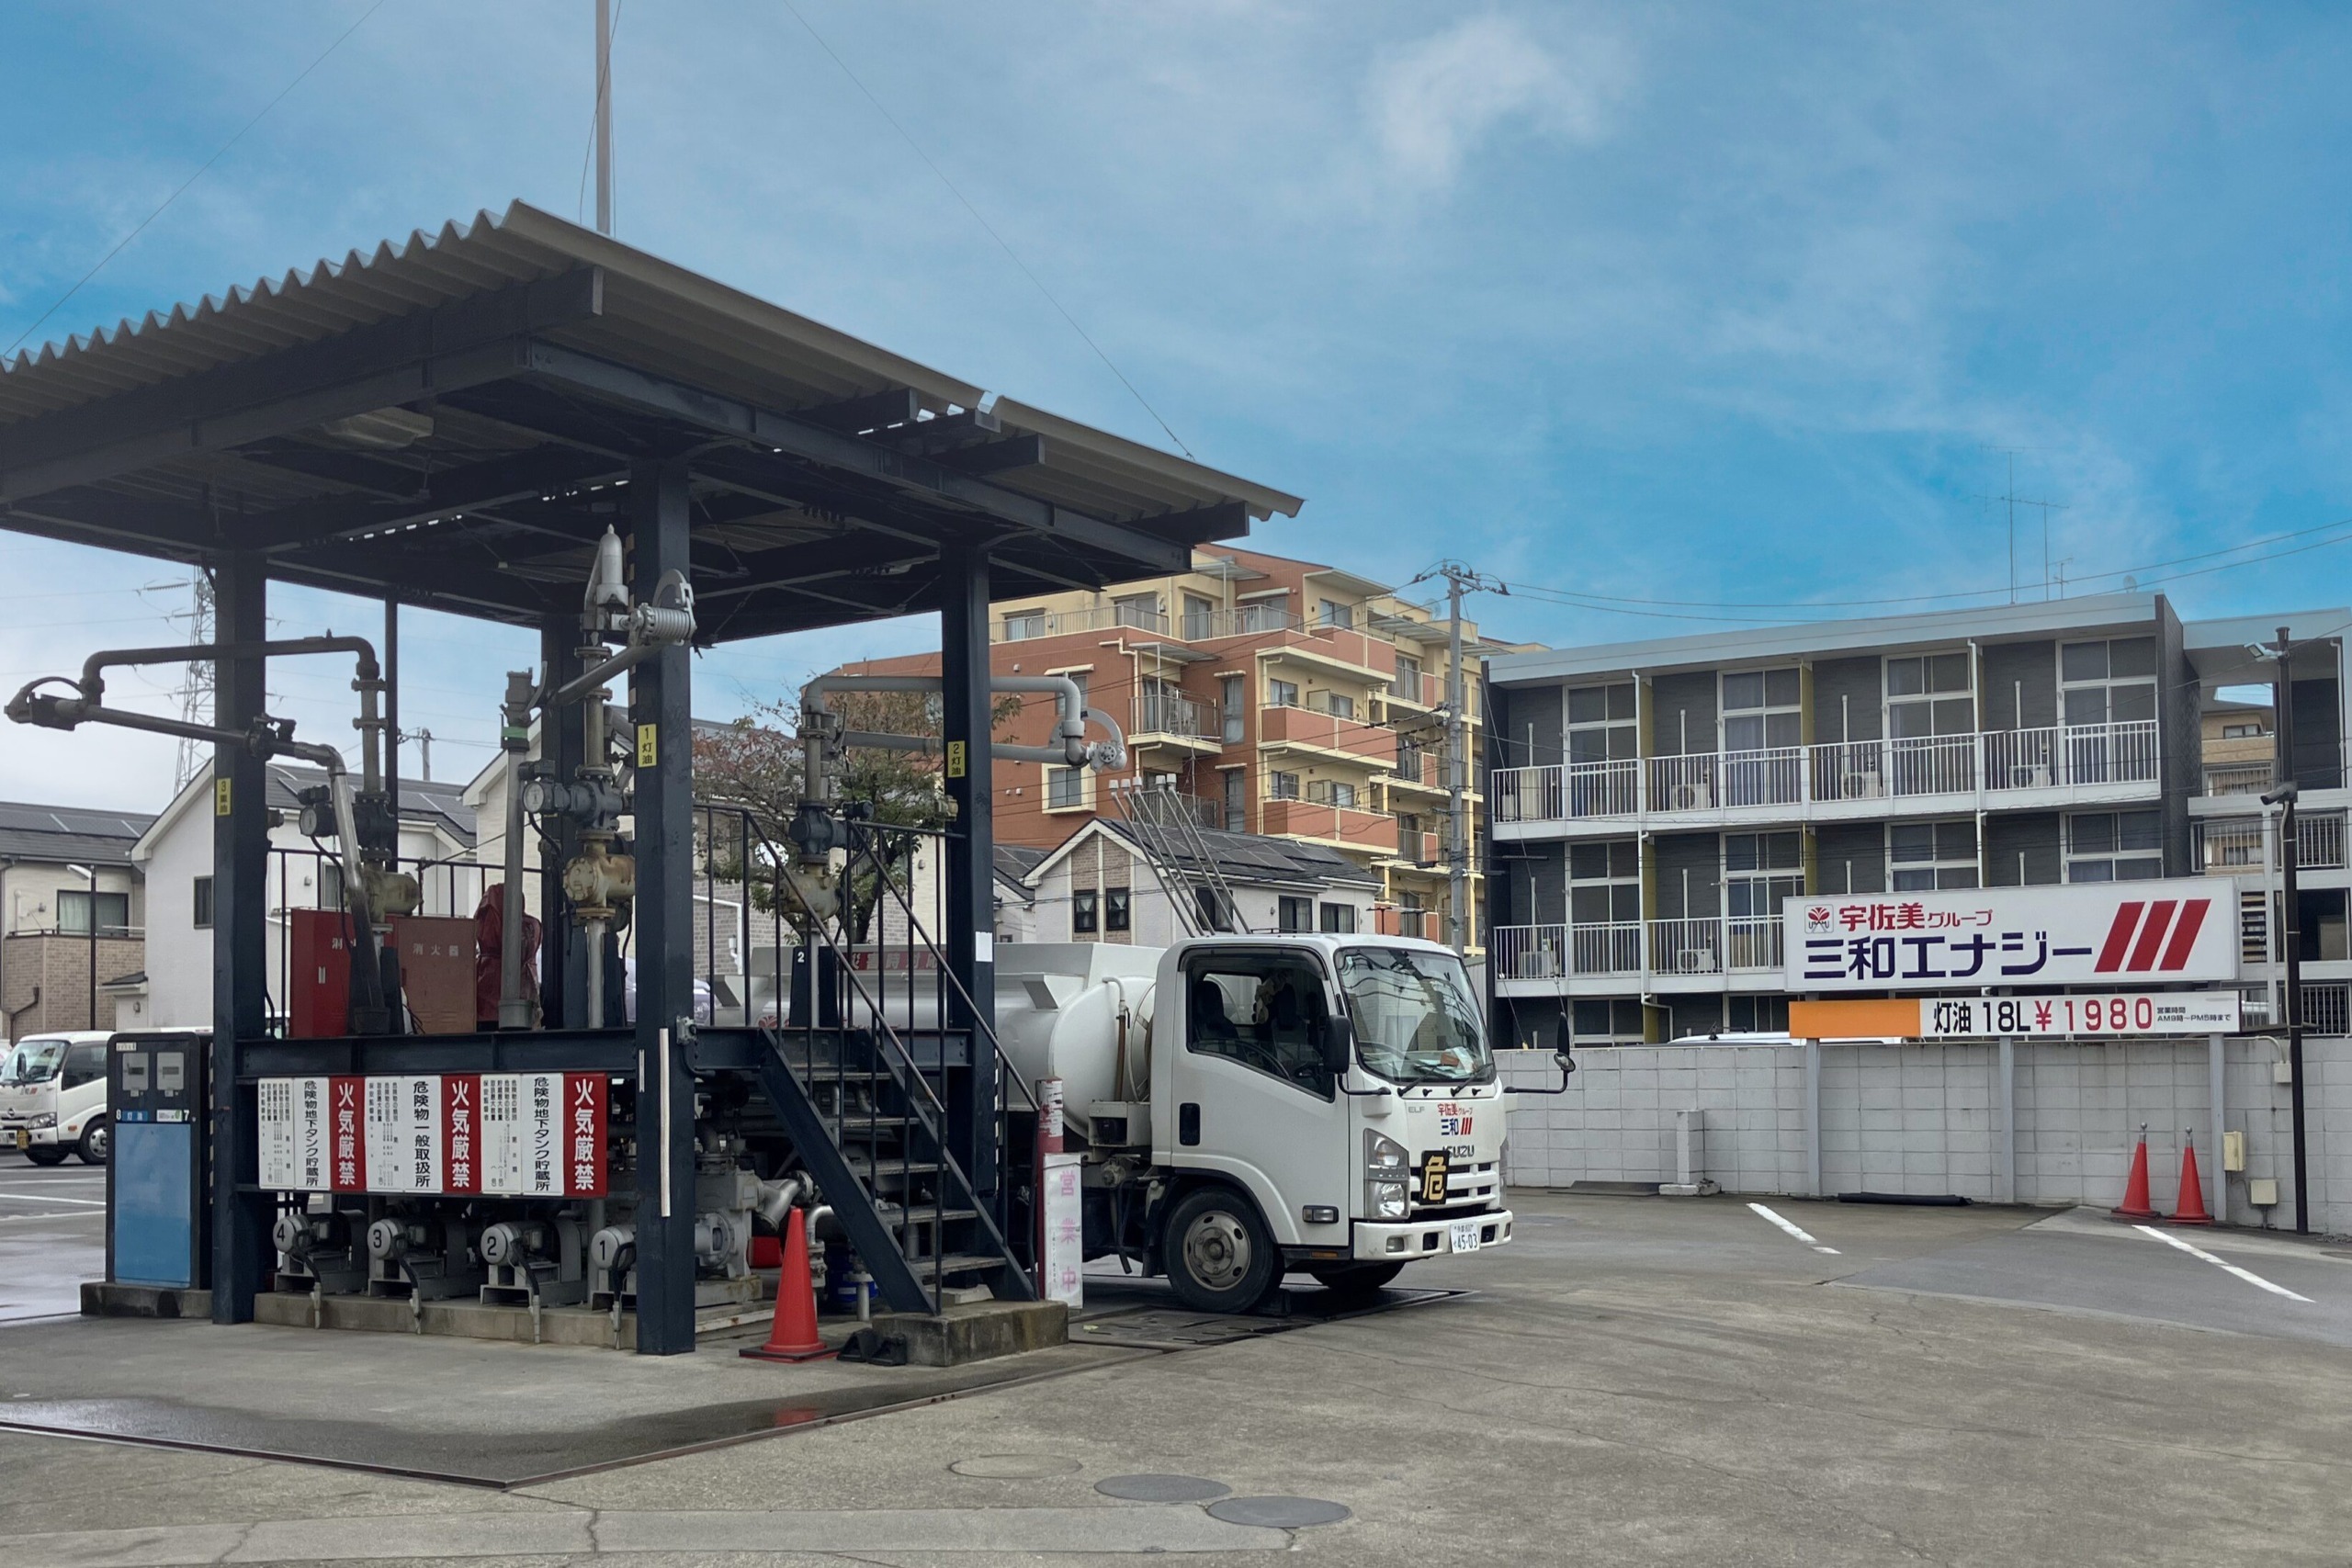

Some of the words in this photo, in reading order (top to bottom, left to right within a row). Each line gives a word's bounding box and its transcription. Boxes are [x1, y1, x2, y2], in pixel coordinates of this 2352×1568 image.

[1838, 902, 1994, 932] 宇佐美グループ
[797, 952, 805, 964] 2
[1804, 931, 2093, 981] 三和エナジー
[1933, 1000, 1973, 1033] 灯油
[1982, 1000, 2031, 1032] 18L
[2034, 998, 2153, 1032] ¥1980
[303, 1079, 319, 1187] 危険物地下タンク貯蔵所
[337, 1082, 356, 1186] 火気厳禁
[413, 1080, 431, 1188] 危険物一般取扱所
[451, 1079, 470, 1188] 火気厳禁
[534, 1077, 551, 1191] 危険物地下タンク貯蔵所
[574, 1077, 594, 1190] 火気厳禁
[1441, 1117, 1459, 1136] 三和
[1422, 1155, 1447, 1201] 危
[277, 1223, 286, 1242] 4
[372, 1228, 382, 1249] 3
[486, 1235, 497, 1257] 2
[598, 1239, 606, 1261] 1
[1059, 1169, 1077, 1292] 営業中
